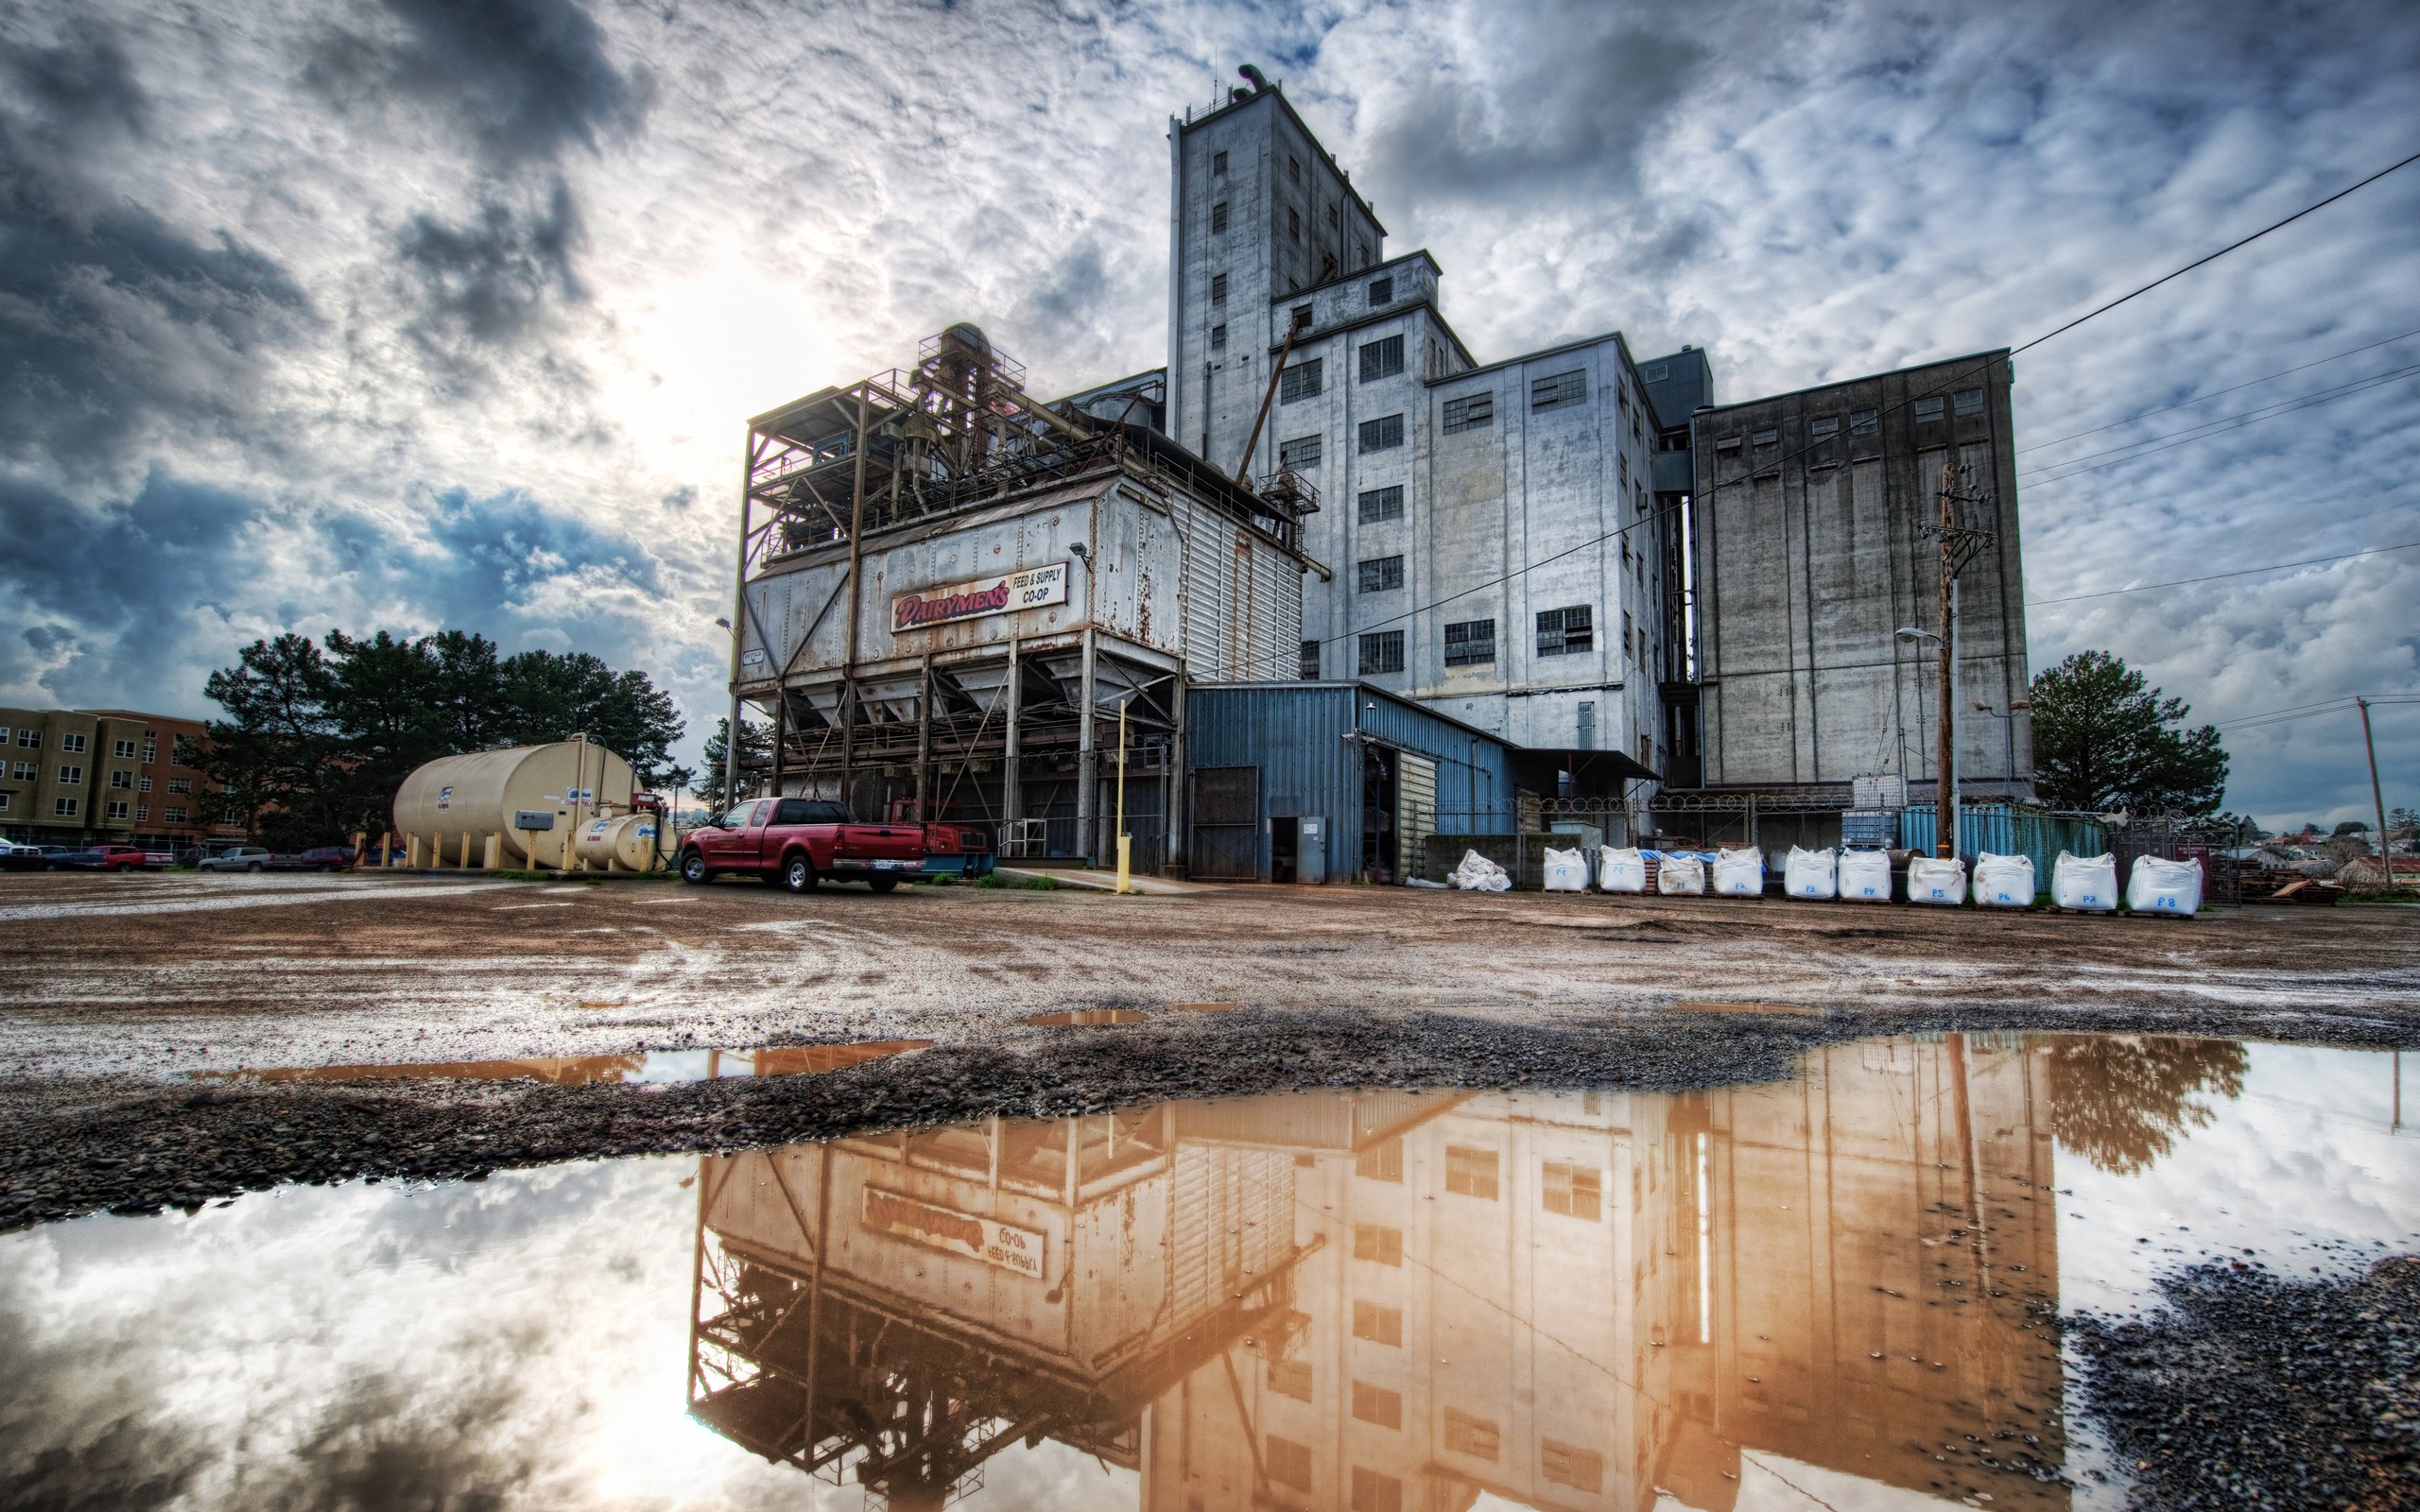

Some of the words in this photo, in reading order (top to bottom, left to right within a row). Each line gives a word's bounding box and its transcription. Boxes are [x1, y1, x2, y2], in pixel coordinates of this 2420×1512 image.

[1012, 575, 1029, 589] FEED
[1029, 573, 1035, 586] &
[1035, 568, 1062, 585] SUPPLY
[1023, 587, 1048, 604] CO-OP
[895, 580, 1010, 628] DAIRYMEN'S
[1806, 885, 1816, 893] P3
[1932, 889, 1945, 898] P5
[2157, 897, 2176, 907] P8
